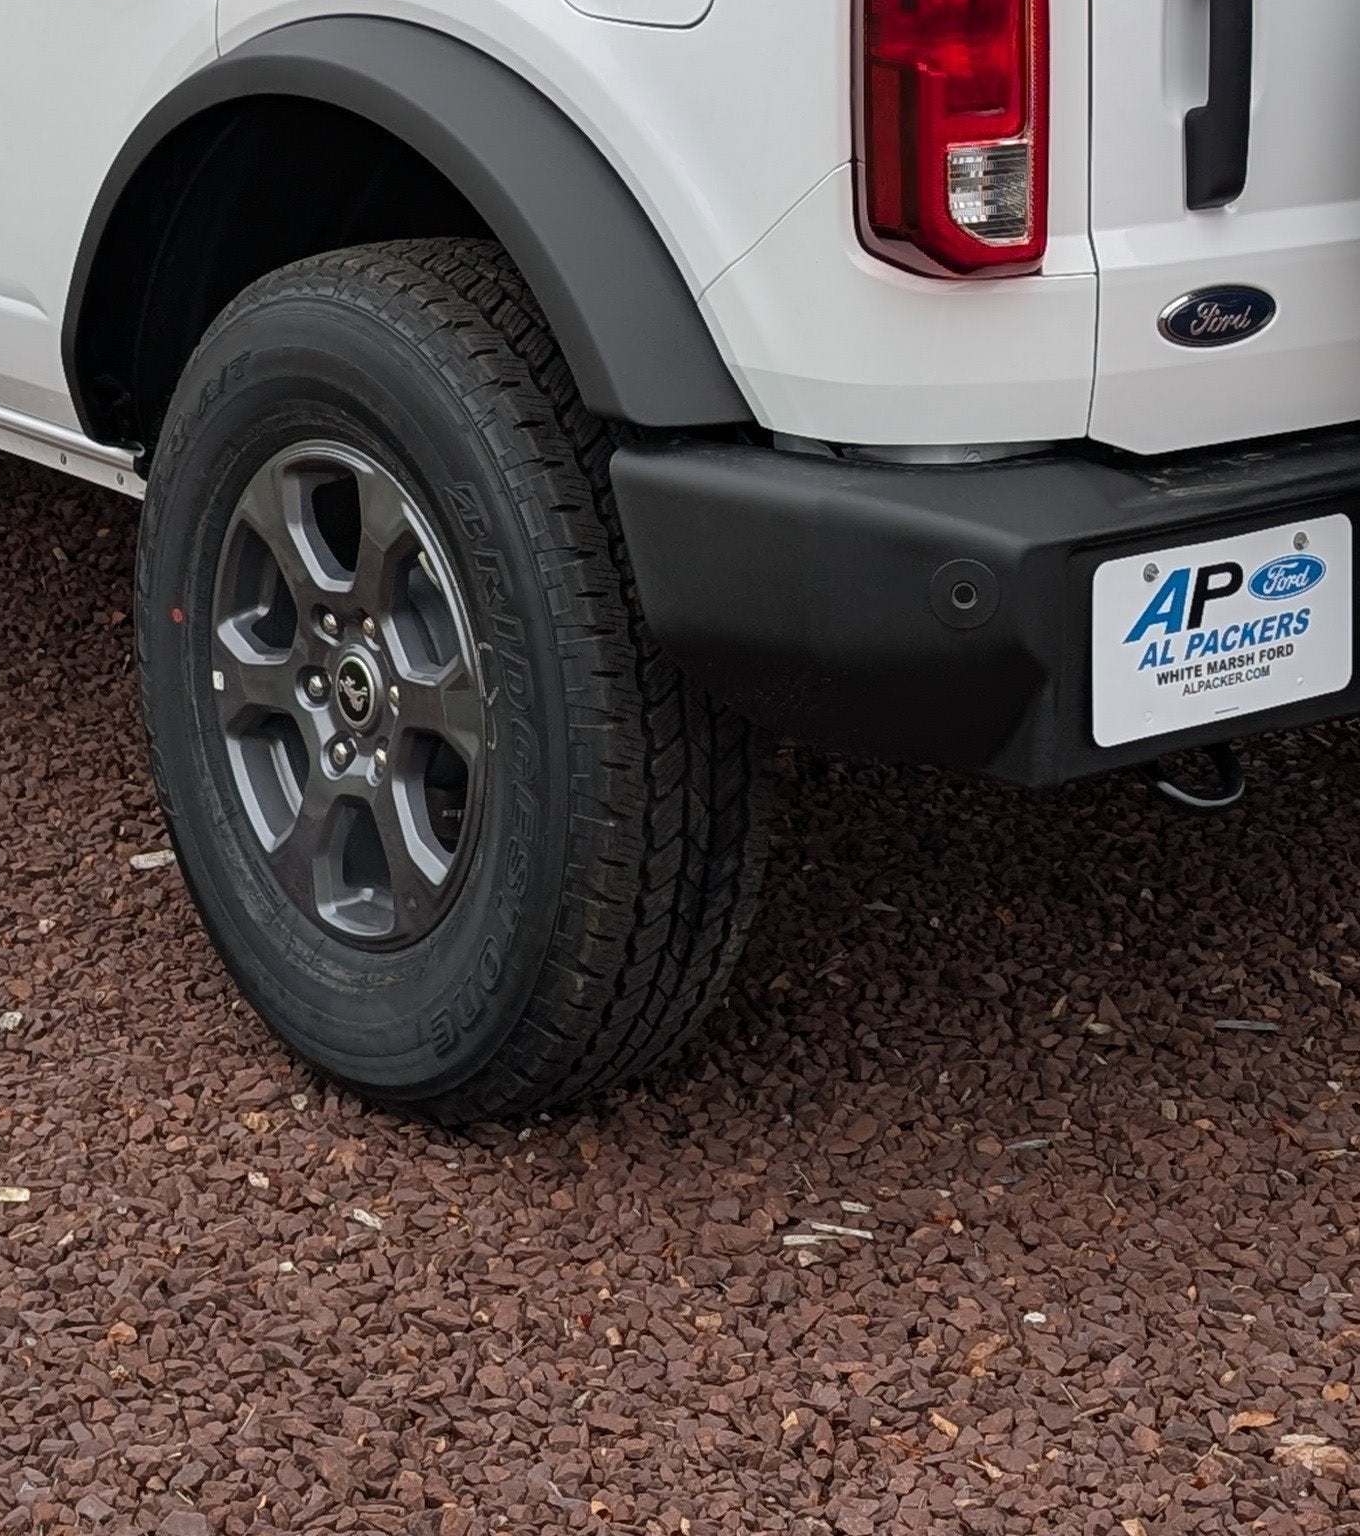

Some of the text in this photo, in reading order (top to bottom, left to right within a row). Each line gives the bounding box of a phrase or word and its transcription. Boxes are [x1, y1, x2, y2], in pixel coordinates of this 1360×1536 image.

[1122, 560, 1245, 646] AP
[1138, 607, 1311, 672] AL PACKERS
[1156, 642, 1295, 687] WHITE MARSH FORD
[1182, 664, 1271, 697] ALPACKER.COM
